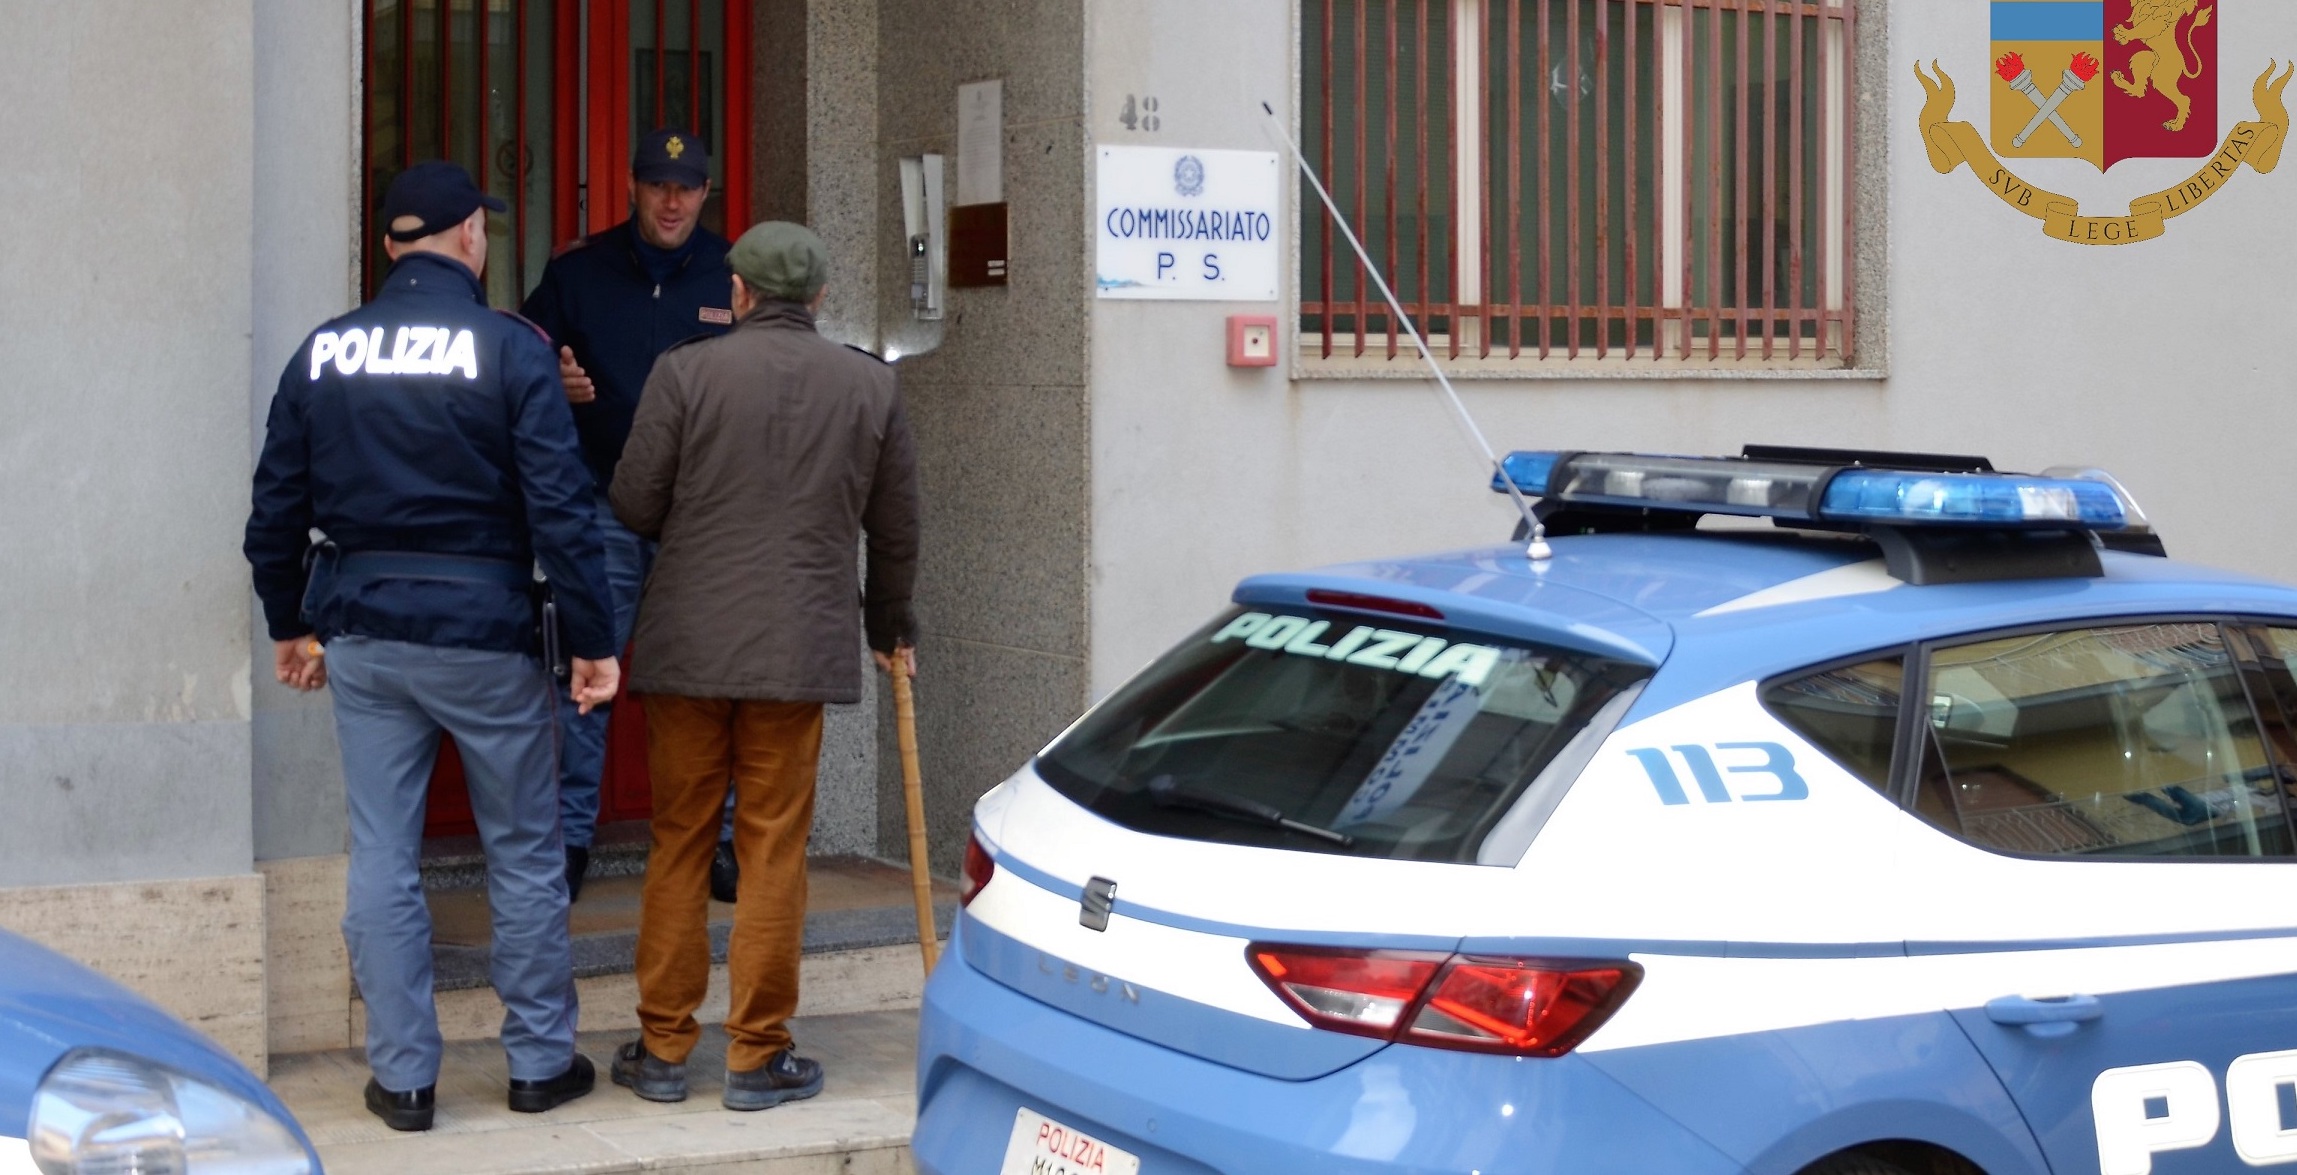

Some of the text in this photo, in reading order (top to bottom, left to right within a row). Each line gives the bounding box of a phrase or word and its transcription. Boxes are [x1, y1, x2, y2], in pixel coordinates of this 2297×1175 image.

[1119, 93, 1161, 131] 48
[1107, 207, 1271, 242] COMMISSARIATO
[310, 326, 478, 381] POLIZIA
[1211, 611, 1501, 686] POLIZIA
[1625, 741, 1810, 806] 113
[1038, 954, 1141, 1005] LEON
[1036, 1122, 1105, 1173] POLIZIA
